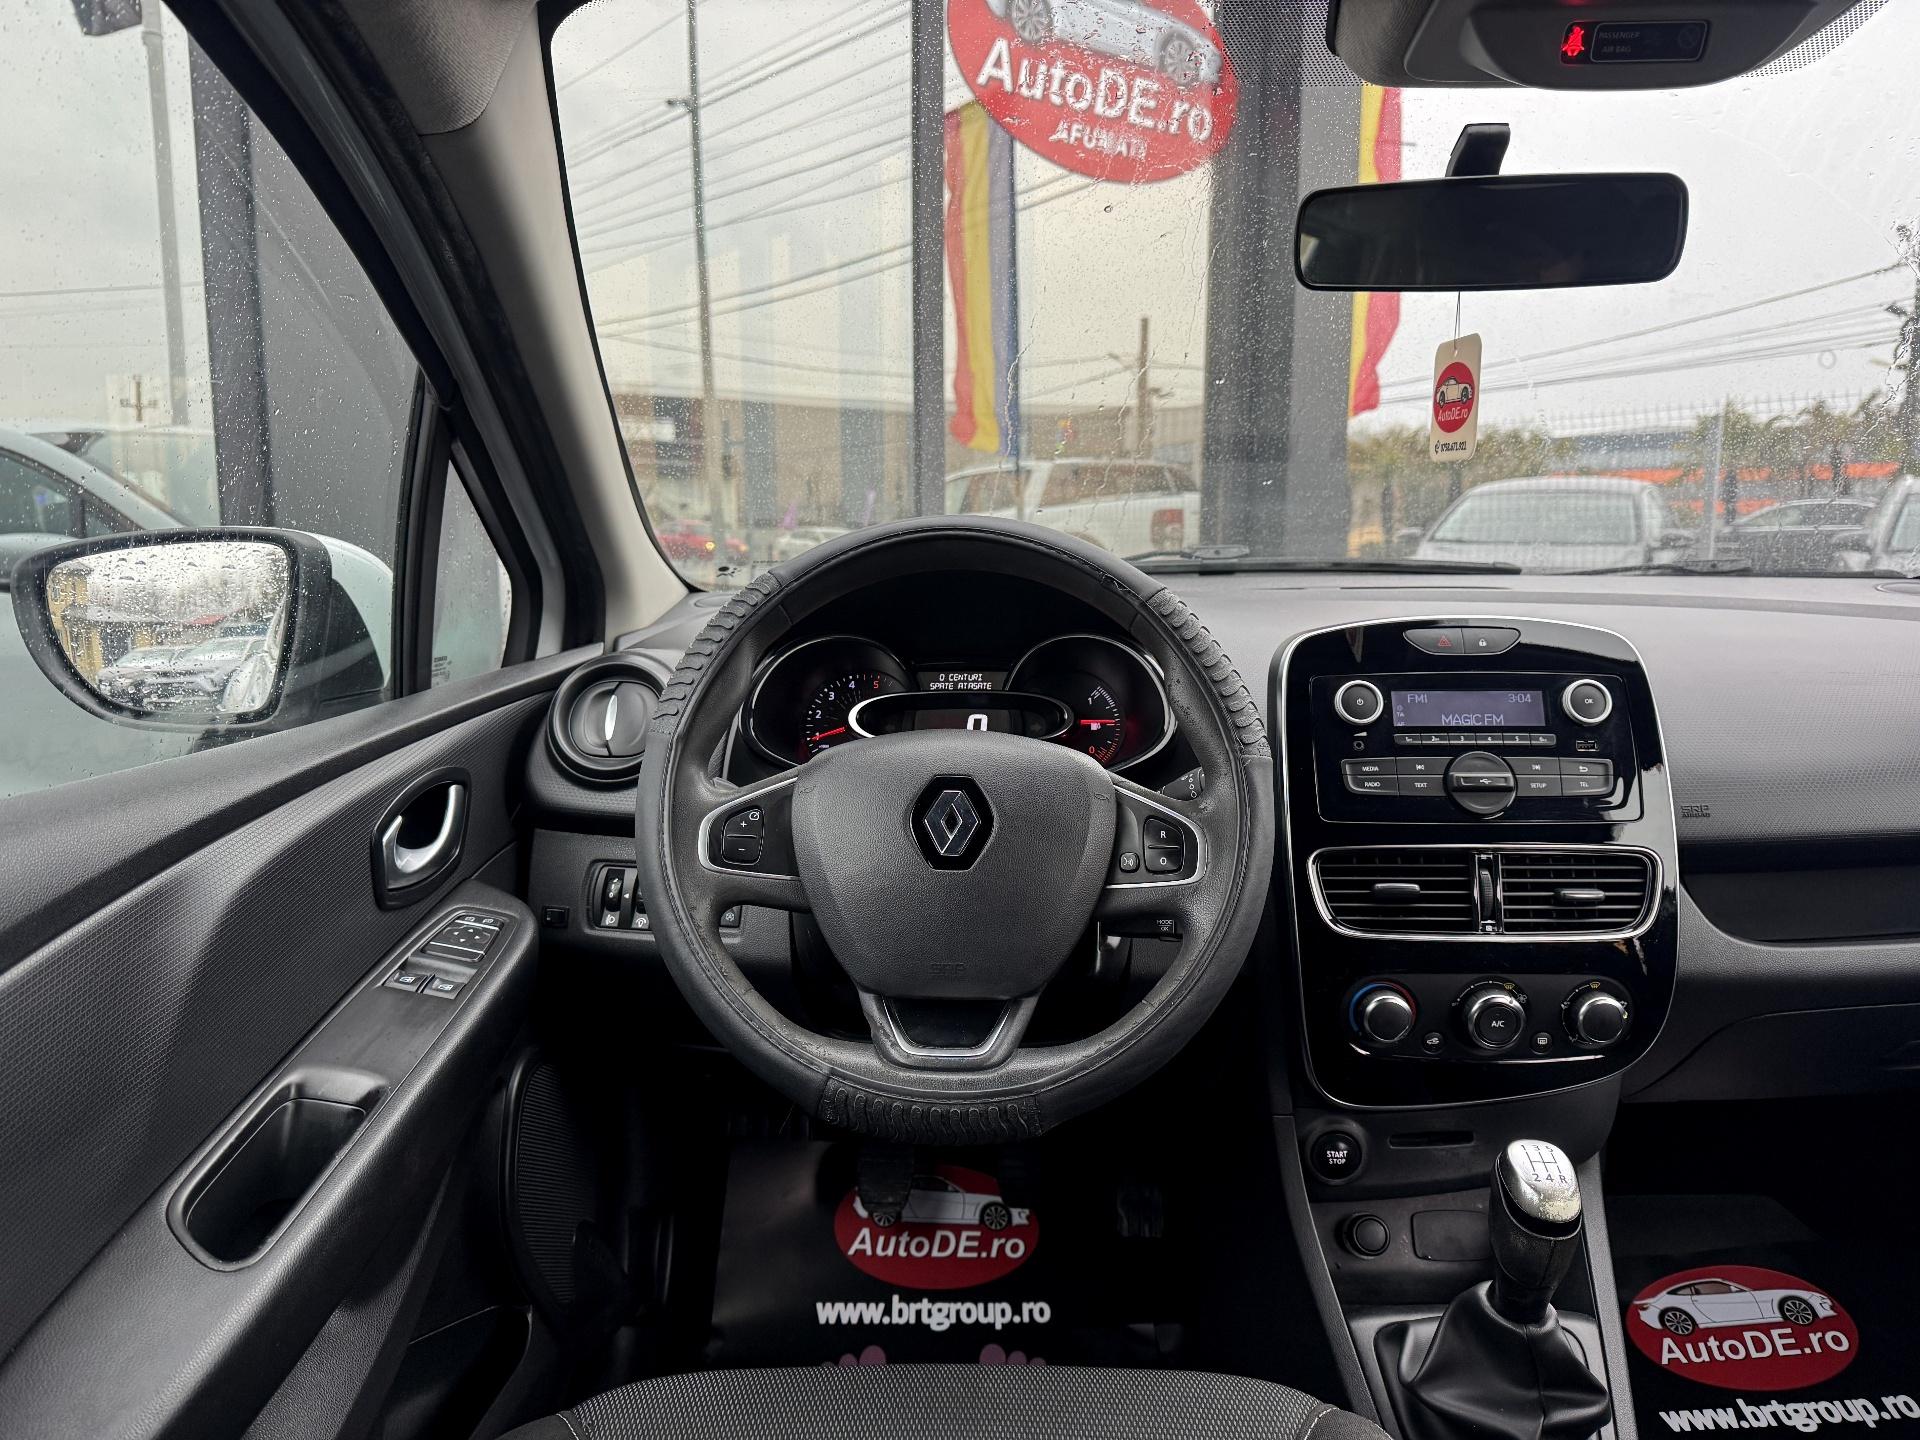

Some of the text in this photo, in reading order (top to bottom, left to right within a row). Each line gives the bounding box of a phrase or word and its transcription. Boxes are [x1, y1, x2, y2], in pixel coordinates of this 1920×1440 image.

[976, 38, 1213, 142] AutoDE.ro
[948, 673, 983, 682] CENTURI
[873, 681, 879, 689] 5
[929, 682, 992, 690] SPATE ATASATE
[828, 692, 835, 700] 3
[815, 709, 822, 719] 2
[1441, 713, 1504, 726] MAGIC FM
[1160, 830, 1167, 839] R
[1491, 1020, 1505, 1028] A/C
[1326, 1150, 1348, 1158] START
[1532, 1173, 1568, 1184] 2 4 R
[848, 1227, 1025, 1259] AutoDE.ro
[816, 1294, 1051, 1332] www.brtgroup.ro
[1661, 1327, 1850, 1365] AutoDE.ro
[1659, 1394, 1920, 1433] www.brtgroup.ro
